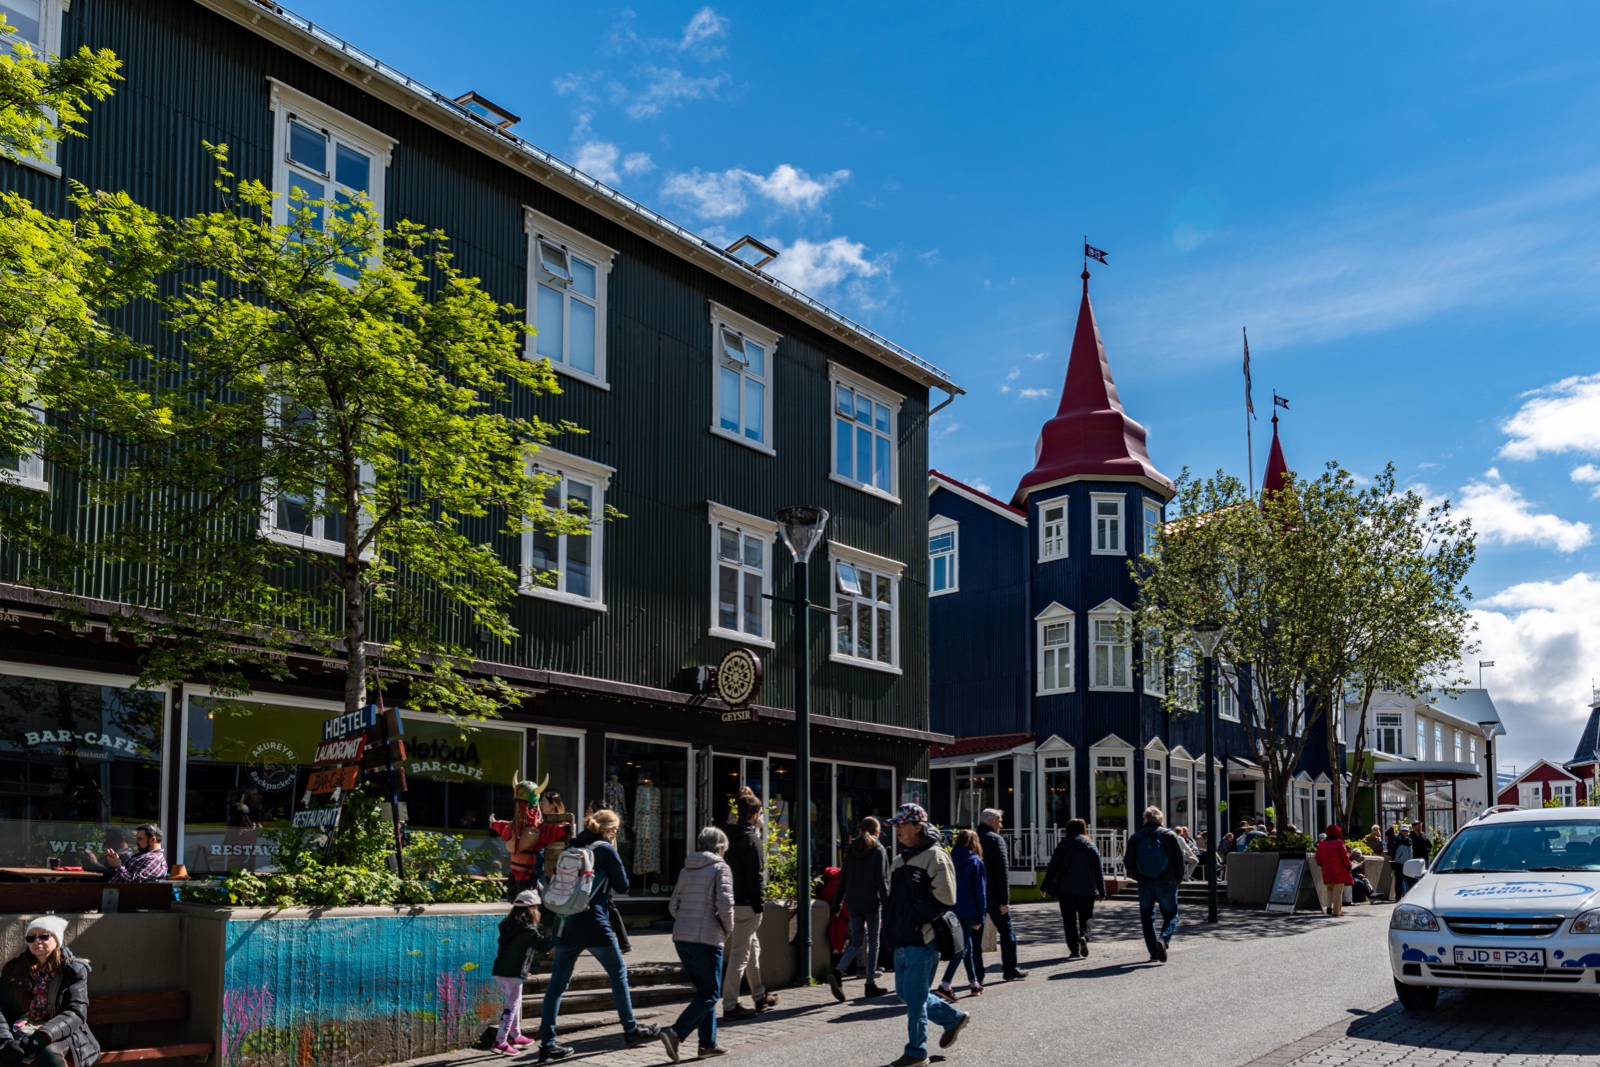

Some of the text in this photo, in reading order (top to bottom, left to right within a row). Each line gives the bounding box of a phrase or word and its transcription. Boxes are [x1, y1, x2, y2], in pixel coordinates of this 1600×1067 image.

[269, 653, 287, 662] BAR
[321, 661, 348, 671] AKUREY
[325, 709, 367, 739] HOSTEL
[721, 710, 752, 722] GEYSIR
[25, 730, 139, 754] BAR-CAFÉ
[252, 742, 296, 760] AKUREYRI
[314, 737, 363, 762] LAUNDROMAT
[58, 747, 109, 759] Restaurant
[411, 761, 484, 781] BAR-CAFÉ
[250, 771, 296, 791] Backpackers
[292, 808, 339, 828] RESTAURANT
[49, 840, 105, 853] WI-FI
[1467, 950, 1490, 962] JD
[1505, 951, 1540, 964] P34
